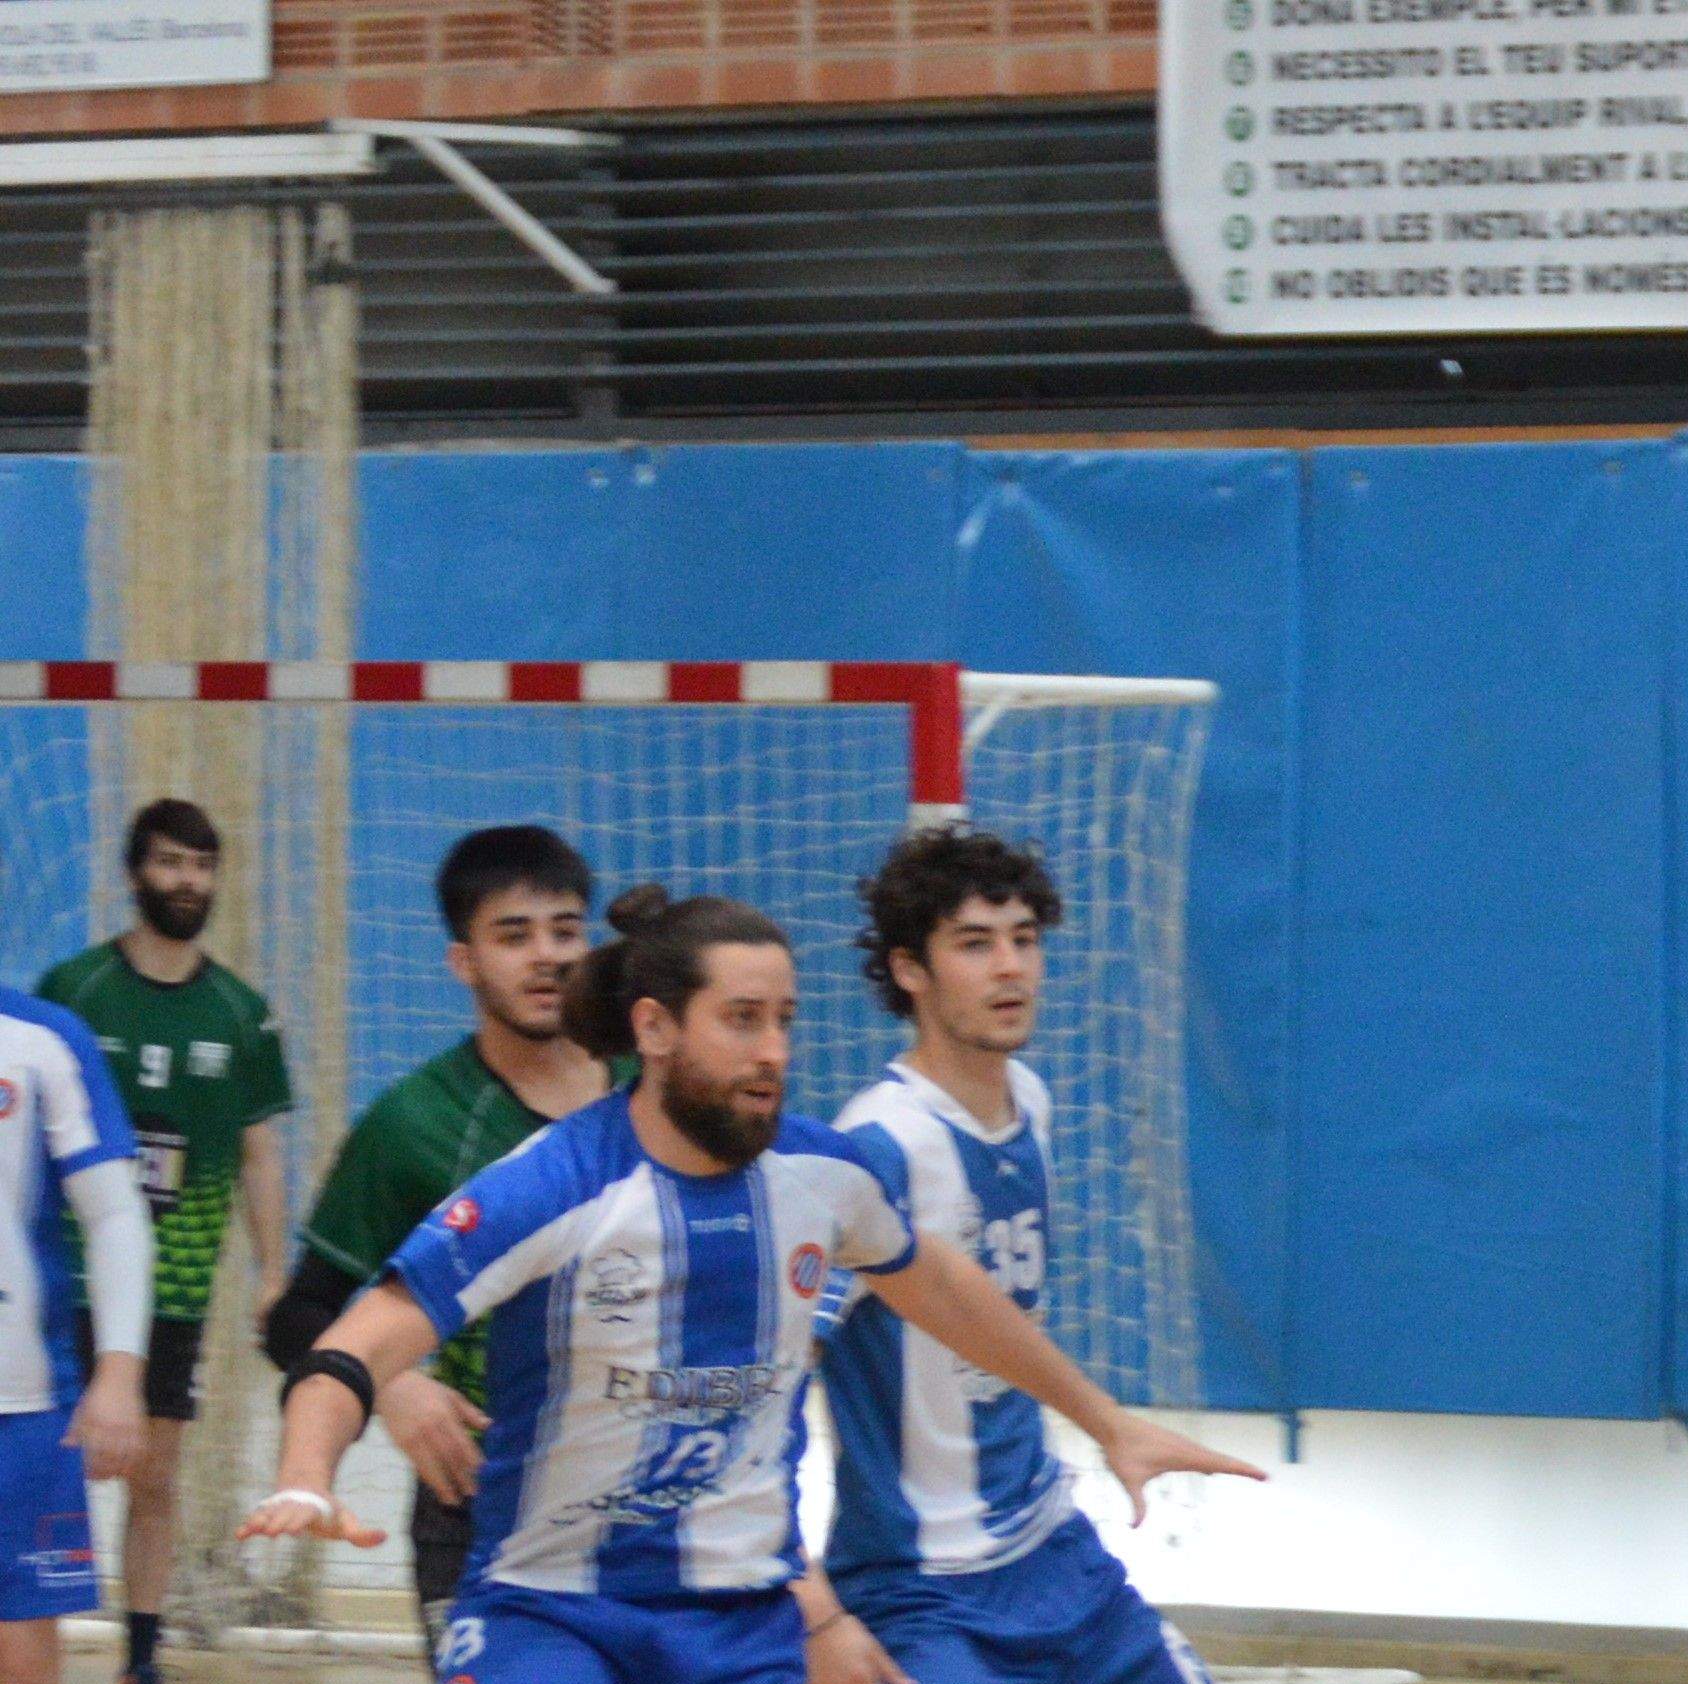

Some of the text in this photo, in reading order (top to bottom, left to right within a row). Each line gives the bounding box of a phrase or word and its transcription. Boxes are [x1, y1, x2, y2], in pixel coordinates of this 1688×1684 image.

[1455, 45, 1489, 77] EL
[1272, 104, 1426, 136] RESPECTA
[1377, 211, 1432, 243] LES
[1461, 265, 1524, 297] QUE
